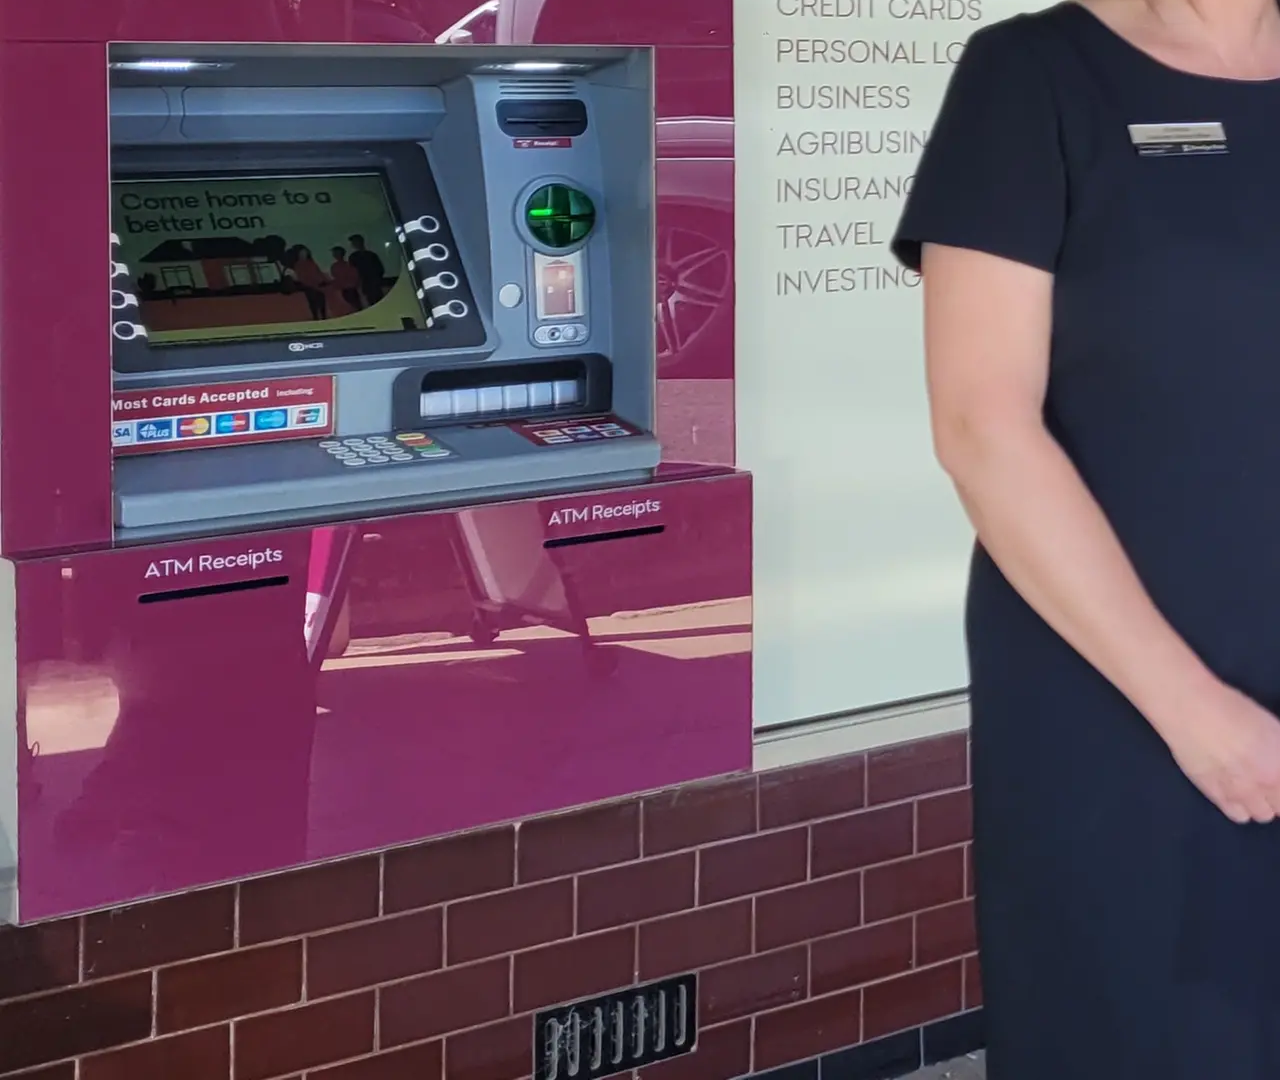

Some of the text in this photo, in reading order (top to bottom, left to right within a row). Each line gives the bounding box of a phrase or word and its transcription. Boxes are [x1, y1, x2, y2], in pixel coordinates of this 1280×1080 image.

[776, 39, 927, 65] PERSONAL
[776, 85, 911, 110] BUSINESS
[120, 189, 332, 211] Come home to a
[123, 212, 266, 234] better loan
[776, 222, 884, 249] TRAVEL
[776, 265, 923, 296] INVESTING
[112, 396, 148, 411] Most
[152, 393, 196, 408] Cards
[199, 387, 269, 404] Accepted
[547, 498, 661, 527] ATM Receipts
[144, 547, 284, 579] ATM Receipts
